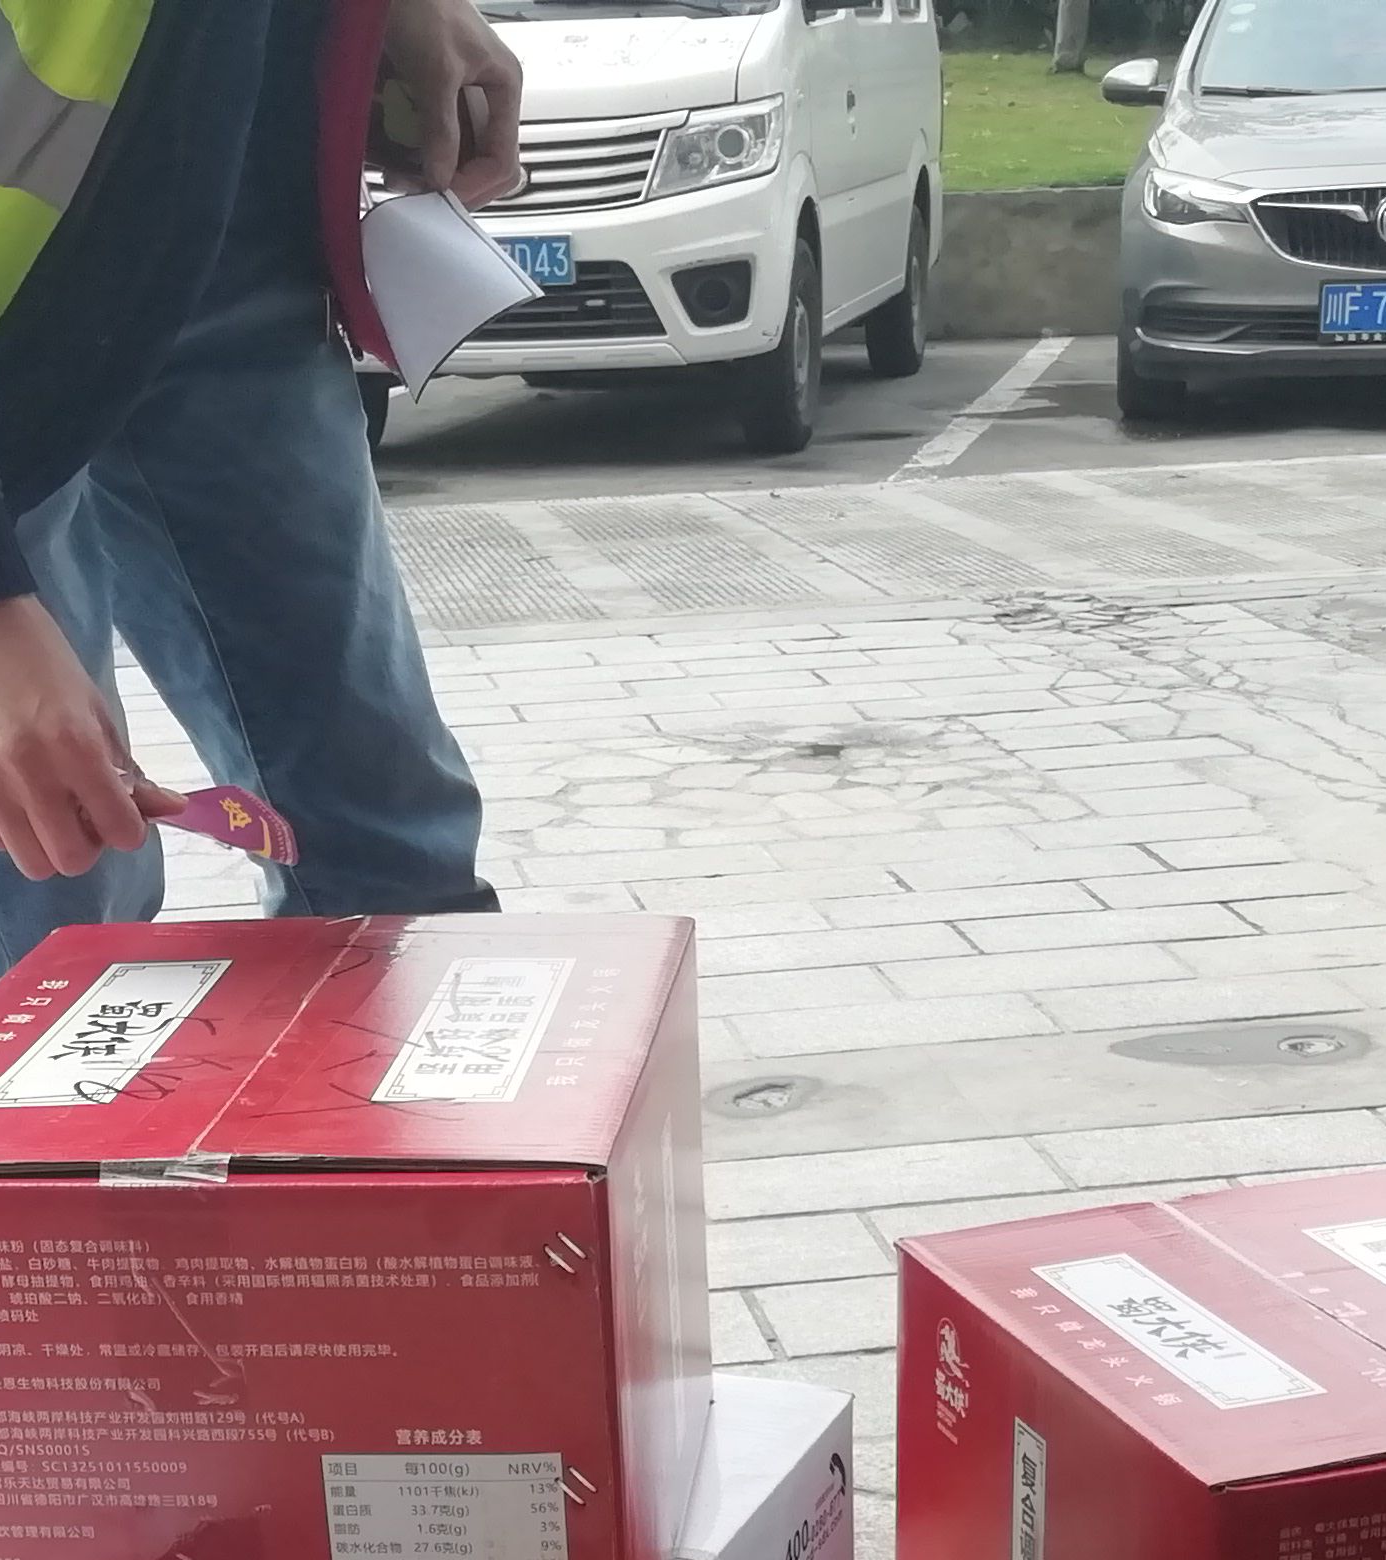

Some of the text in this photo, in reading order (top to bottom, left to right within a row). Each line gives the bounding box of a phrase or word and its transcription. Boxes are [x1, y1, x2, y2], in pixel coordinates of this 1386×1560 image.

[502, 242, 570, 277] D43
[46, 999, 175, 1061] 蜀大侠
[1103, 1294, 1231, 1361] 蜀大侠
[395, 1429, 483, 1446] 营养成分表
[327, 1461, 557, 1478] 项目 每100(g) NRV%
[330, 1486, 357, 1498] 能量
[529, 1483, 558, 1495] 13%
[332, 1504, 372, 1517] 蛋白质
[530, 1502, 559, 1514] 56%
[333, 1523, 361, 1535] 脂肪
[540, 1521, 560, 1533] 3%
[336, 1542, 402, 1555] 碳水化合物
[540, 1540, 561, 1552] 9%
